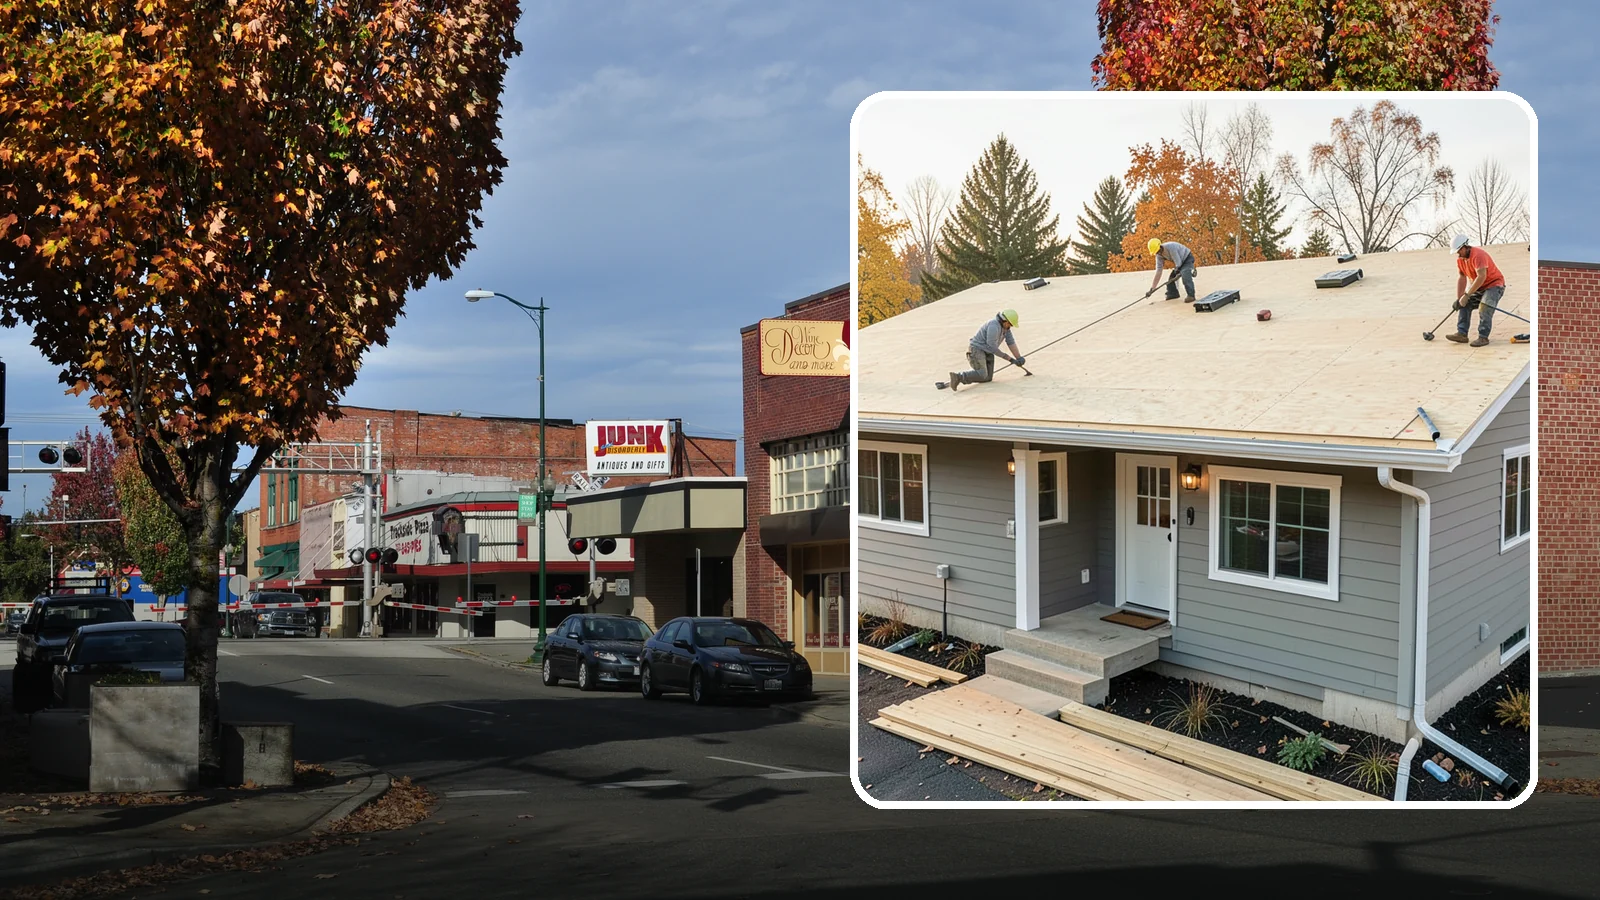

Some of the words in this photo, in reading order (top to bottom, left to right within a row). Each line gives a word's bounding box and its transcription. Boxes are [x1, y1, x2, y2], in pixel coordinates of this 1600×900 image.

[595, 425, 665, 457] JUNK
[607, 446, 646, 454] DISORDERLY
[597, 461, 628, 470] ANTIQUES
[631, 461, 644, 470] AND
[647, 460, 665, 469] GIFTS
[414, 519, 429, 535] Pizza
